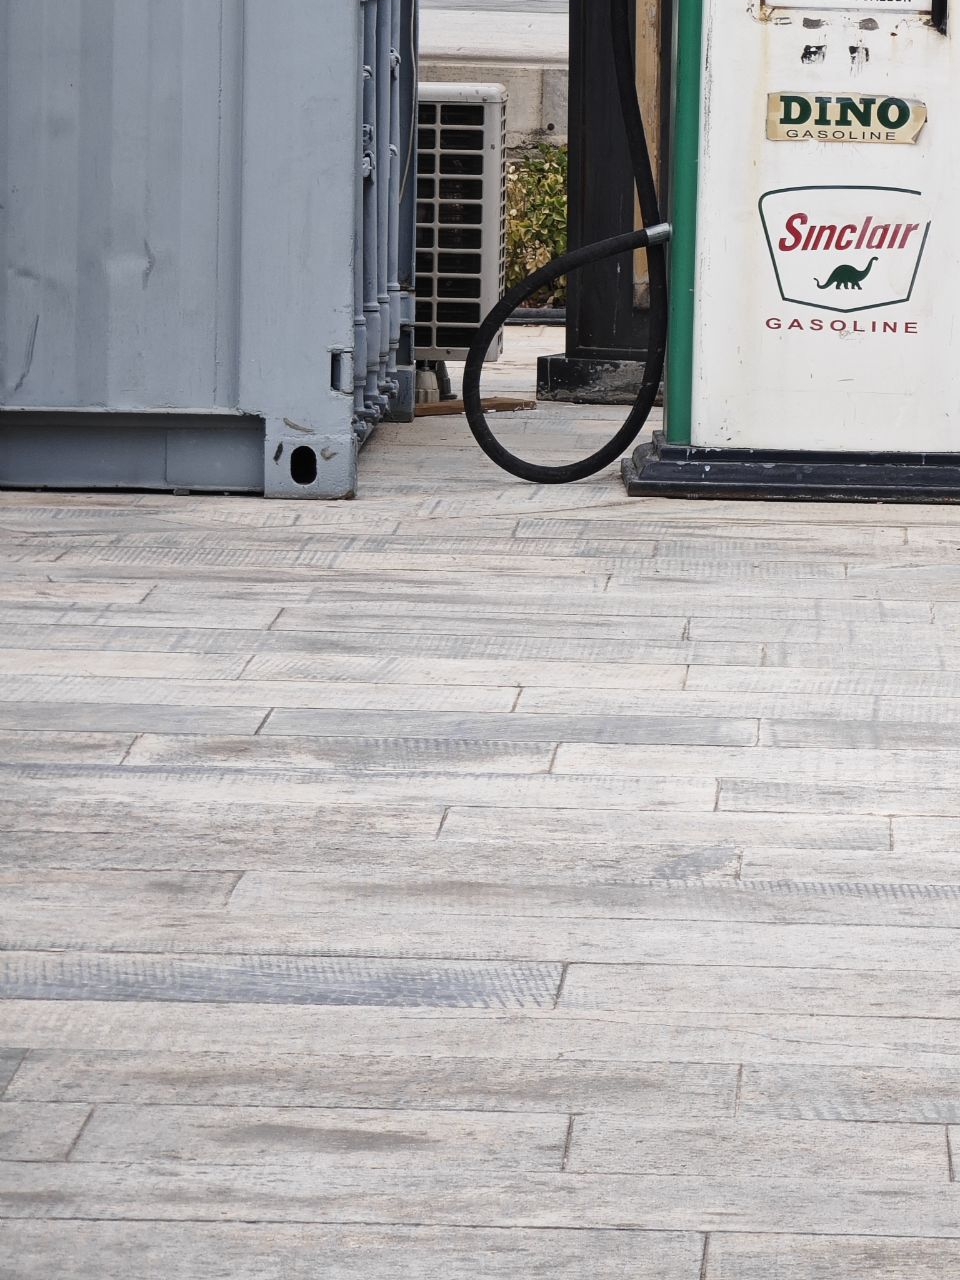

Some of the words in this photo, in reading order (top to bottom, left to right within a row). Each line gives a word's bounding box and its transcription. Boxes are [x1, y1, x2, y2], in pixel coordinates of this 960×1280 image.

[779, 95, 911, 130] DINO
[786, 129, 897, 141] GASOLINE
[778, 212, 920, 253] Sinclair
[765, 316, 919, 334] GASOLINE
